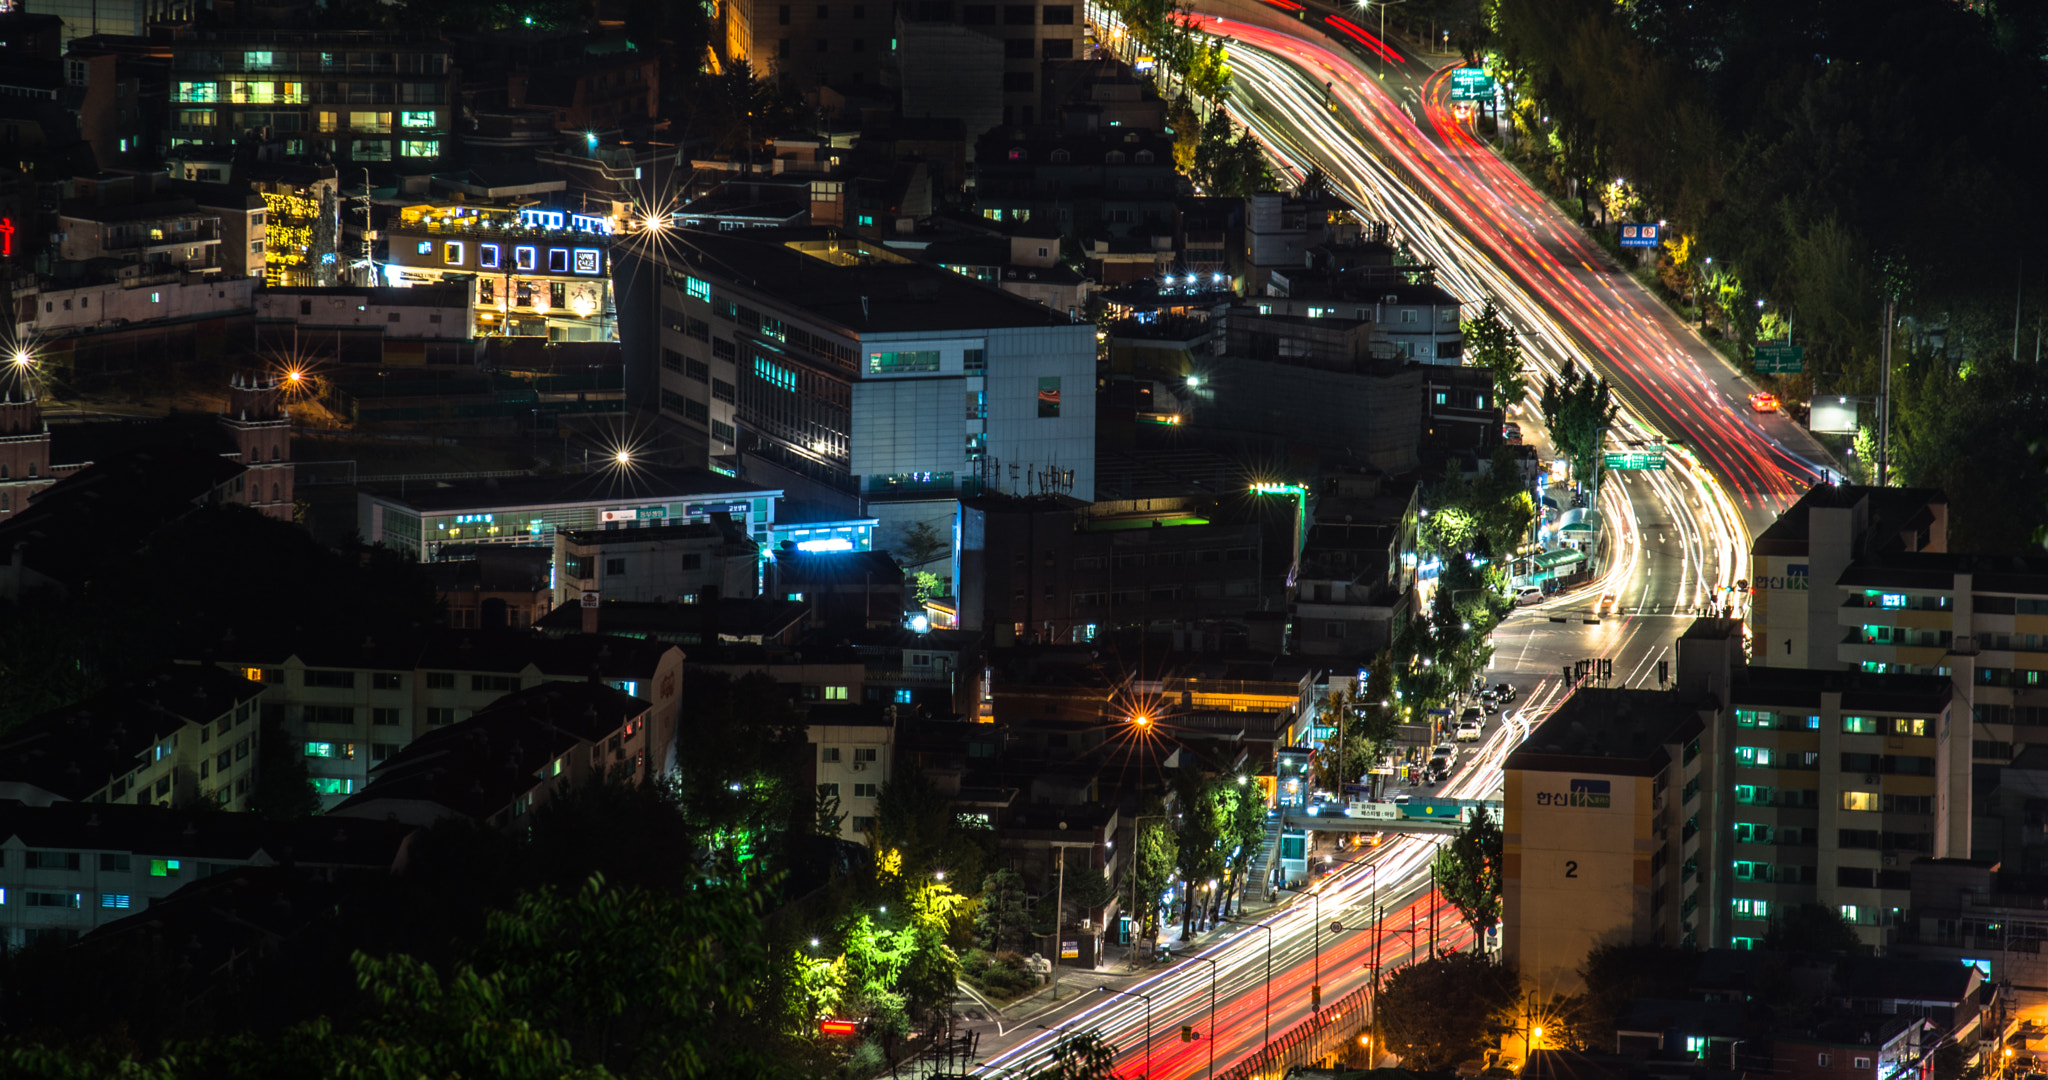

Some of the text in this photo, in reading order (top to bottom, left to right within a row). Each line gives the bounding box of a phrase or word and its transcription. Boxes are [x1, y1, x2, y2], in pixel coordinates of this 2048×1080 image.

[1755, 575, 1784, 590] 한신
[1784, 638, 1792, 655] 1
[1536, 791, 1568, 807] 한신
[1565, 860, 1578, 878] 2
